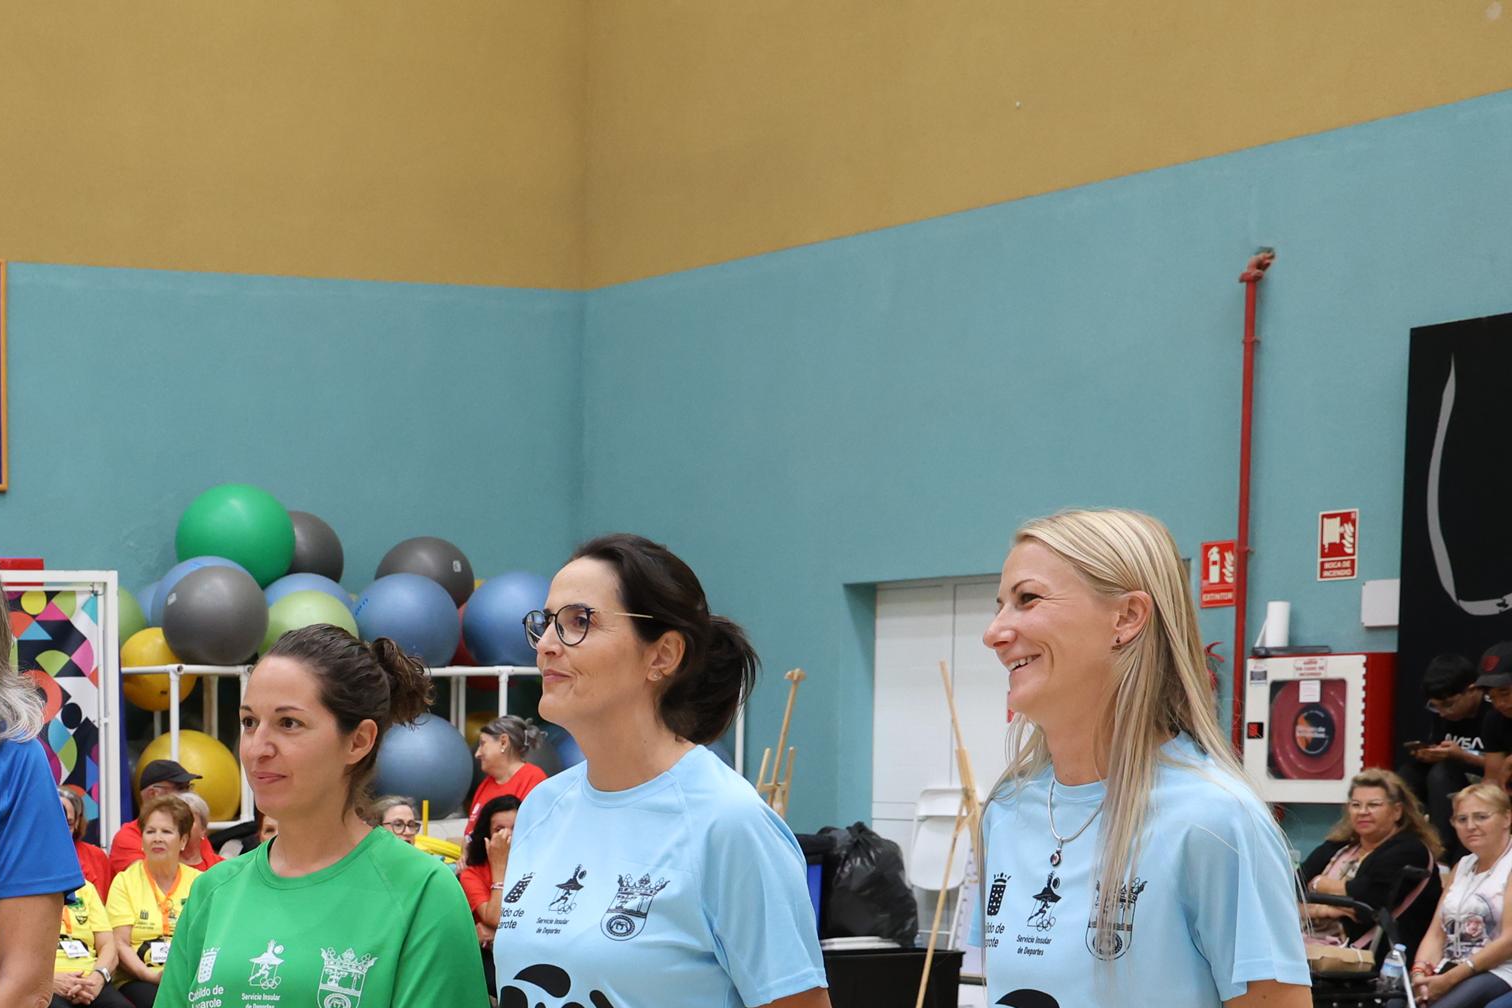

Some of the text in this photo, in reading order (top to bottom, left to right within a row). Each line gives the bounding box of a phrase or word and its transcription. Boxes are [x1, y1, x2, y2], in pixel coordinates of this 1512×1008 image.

[512, 908, 525, 917] de
[995, 923, 1005, 934] de
[1017, 934, 1052, 944] Servicio Insular
[1017, 946, 1044, 956] de Deportes
[212, 984, 224, 995] de
